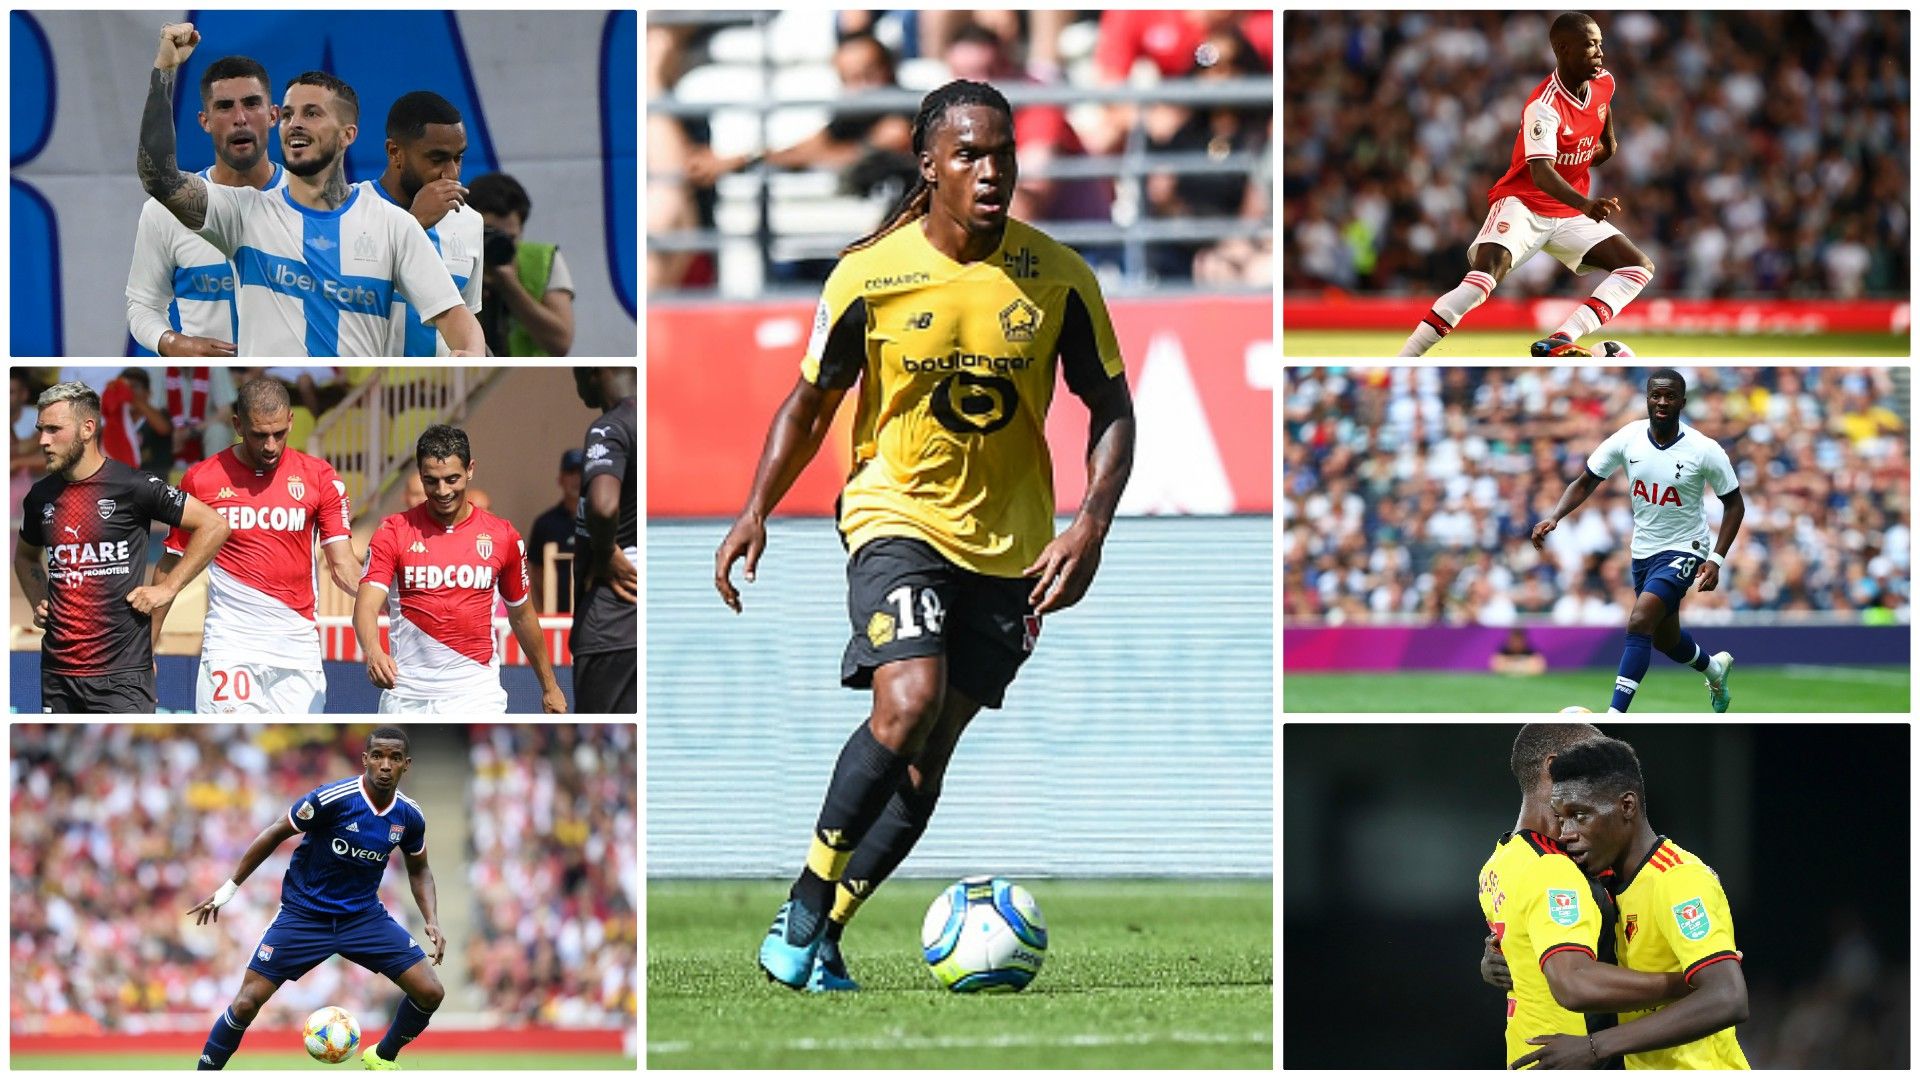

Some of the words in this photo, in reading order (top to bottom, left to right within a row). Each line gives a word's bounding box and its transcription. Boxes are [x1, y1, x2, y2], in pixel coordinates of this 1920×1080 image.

[1578, 136, 1594, 149] Fly
[268, 263, 316, 293] Uber
[322, 279, 376, 305] Eats
[903, 352, 1034, 370] boulanger
[1633, 480, 1682, 507] AIA
[83, 566, 130, 577] PROMOTEUR
[404, 565, 492, 590] FEDCOM
[1668, 556, 1697, 578] 28
[212, 671, 250, 701] 20
